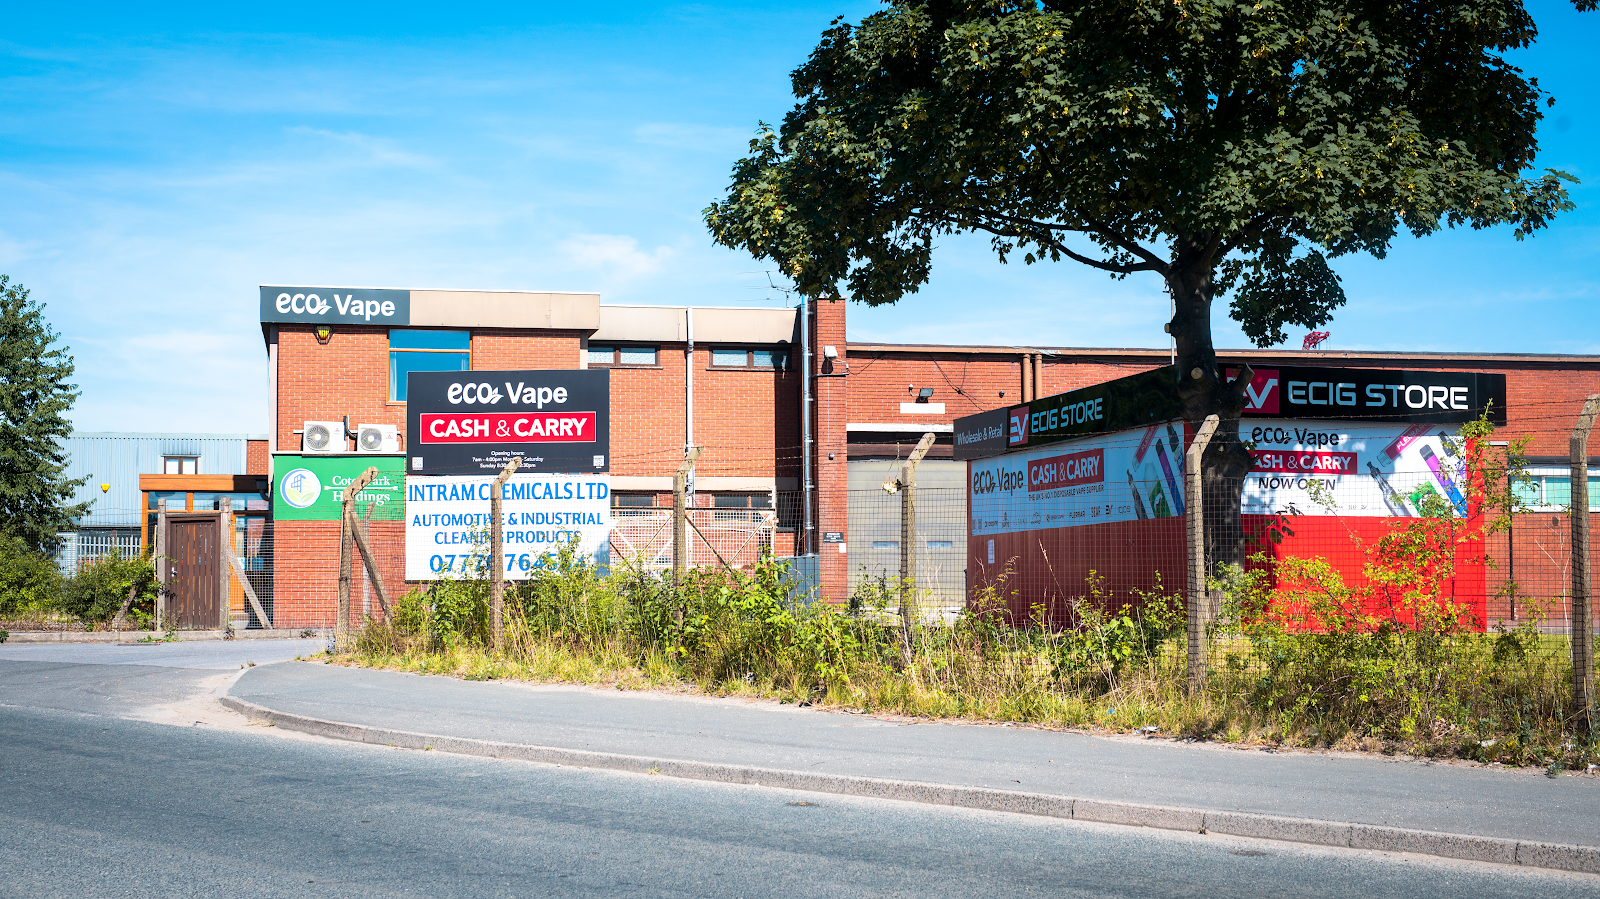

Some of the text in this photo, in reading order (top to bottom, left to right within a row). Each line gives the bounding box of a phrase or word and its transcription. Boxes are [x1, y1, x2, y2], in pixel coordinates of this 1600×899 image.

[276, 293, 395, 321] eco Vape
[447, 382, 567, 409] eco Vape
[1288, 380, 1357, 406] ECIG
[1365, 384, 1469, 410] STORE
[1031, 408, 1058, 433] ECIG
[1060, 397, 1103, 428] STORE
[430, 418, 587, 437] CASH & CARRY
[957, 423, 1003, 446] Wholesale & Retail
[1252, 427, 1340, 449] eco Vape
[1031, 455, 1100, 485] CASH & CARRY
[1254, 454, 1351, 470] ASH & CARRY
[368, 475, 391, 486] ark
[973, 466, 1024, 496] eco Vape
[1258, 477, 1294, 489] NOW
[332, 491, 391, 506] Hdings
[408, 482, 608, 502] INTRAM CEMICALS LTD
[507, 512, 518, 526] &
[521, 511, 604, 526] INDUSTRIAL
